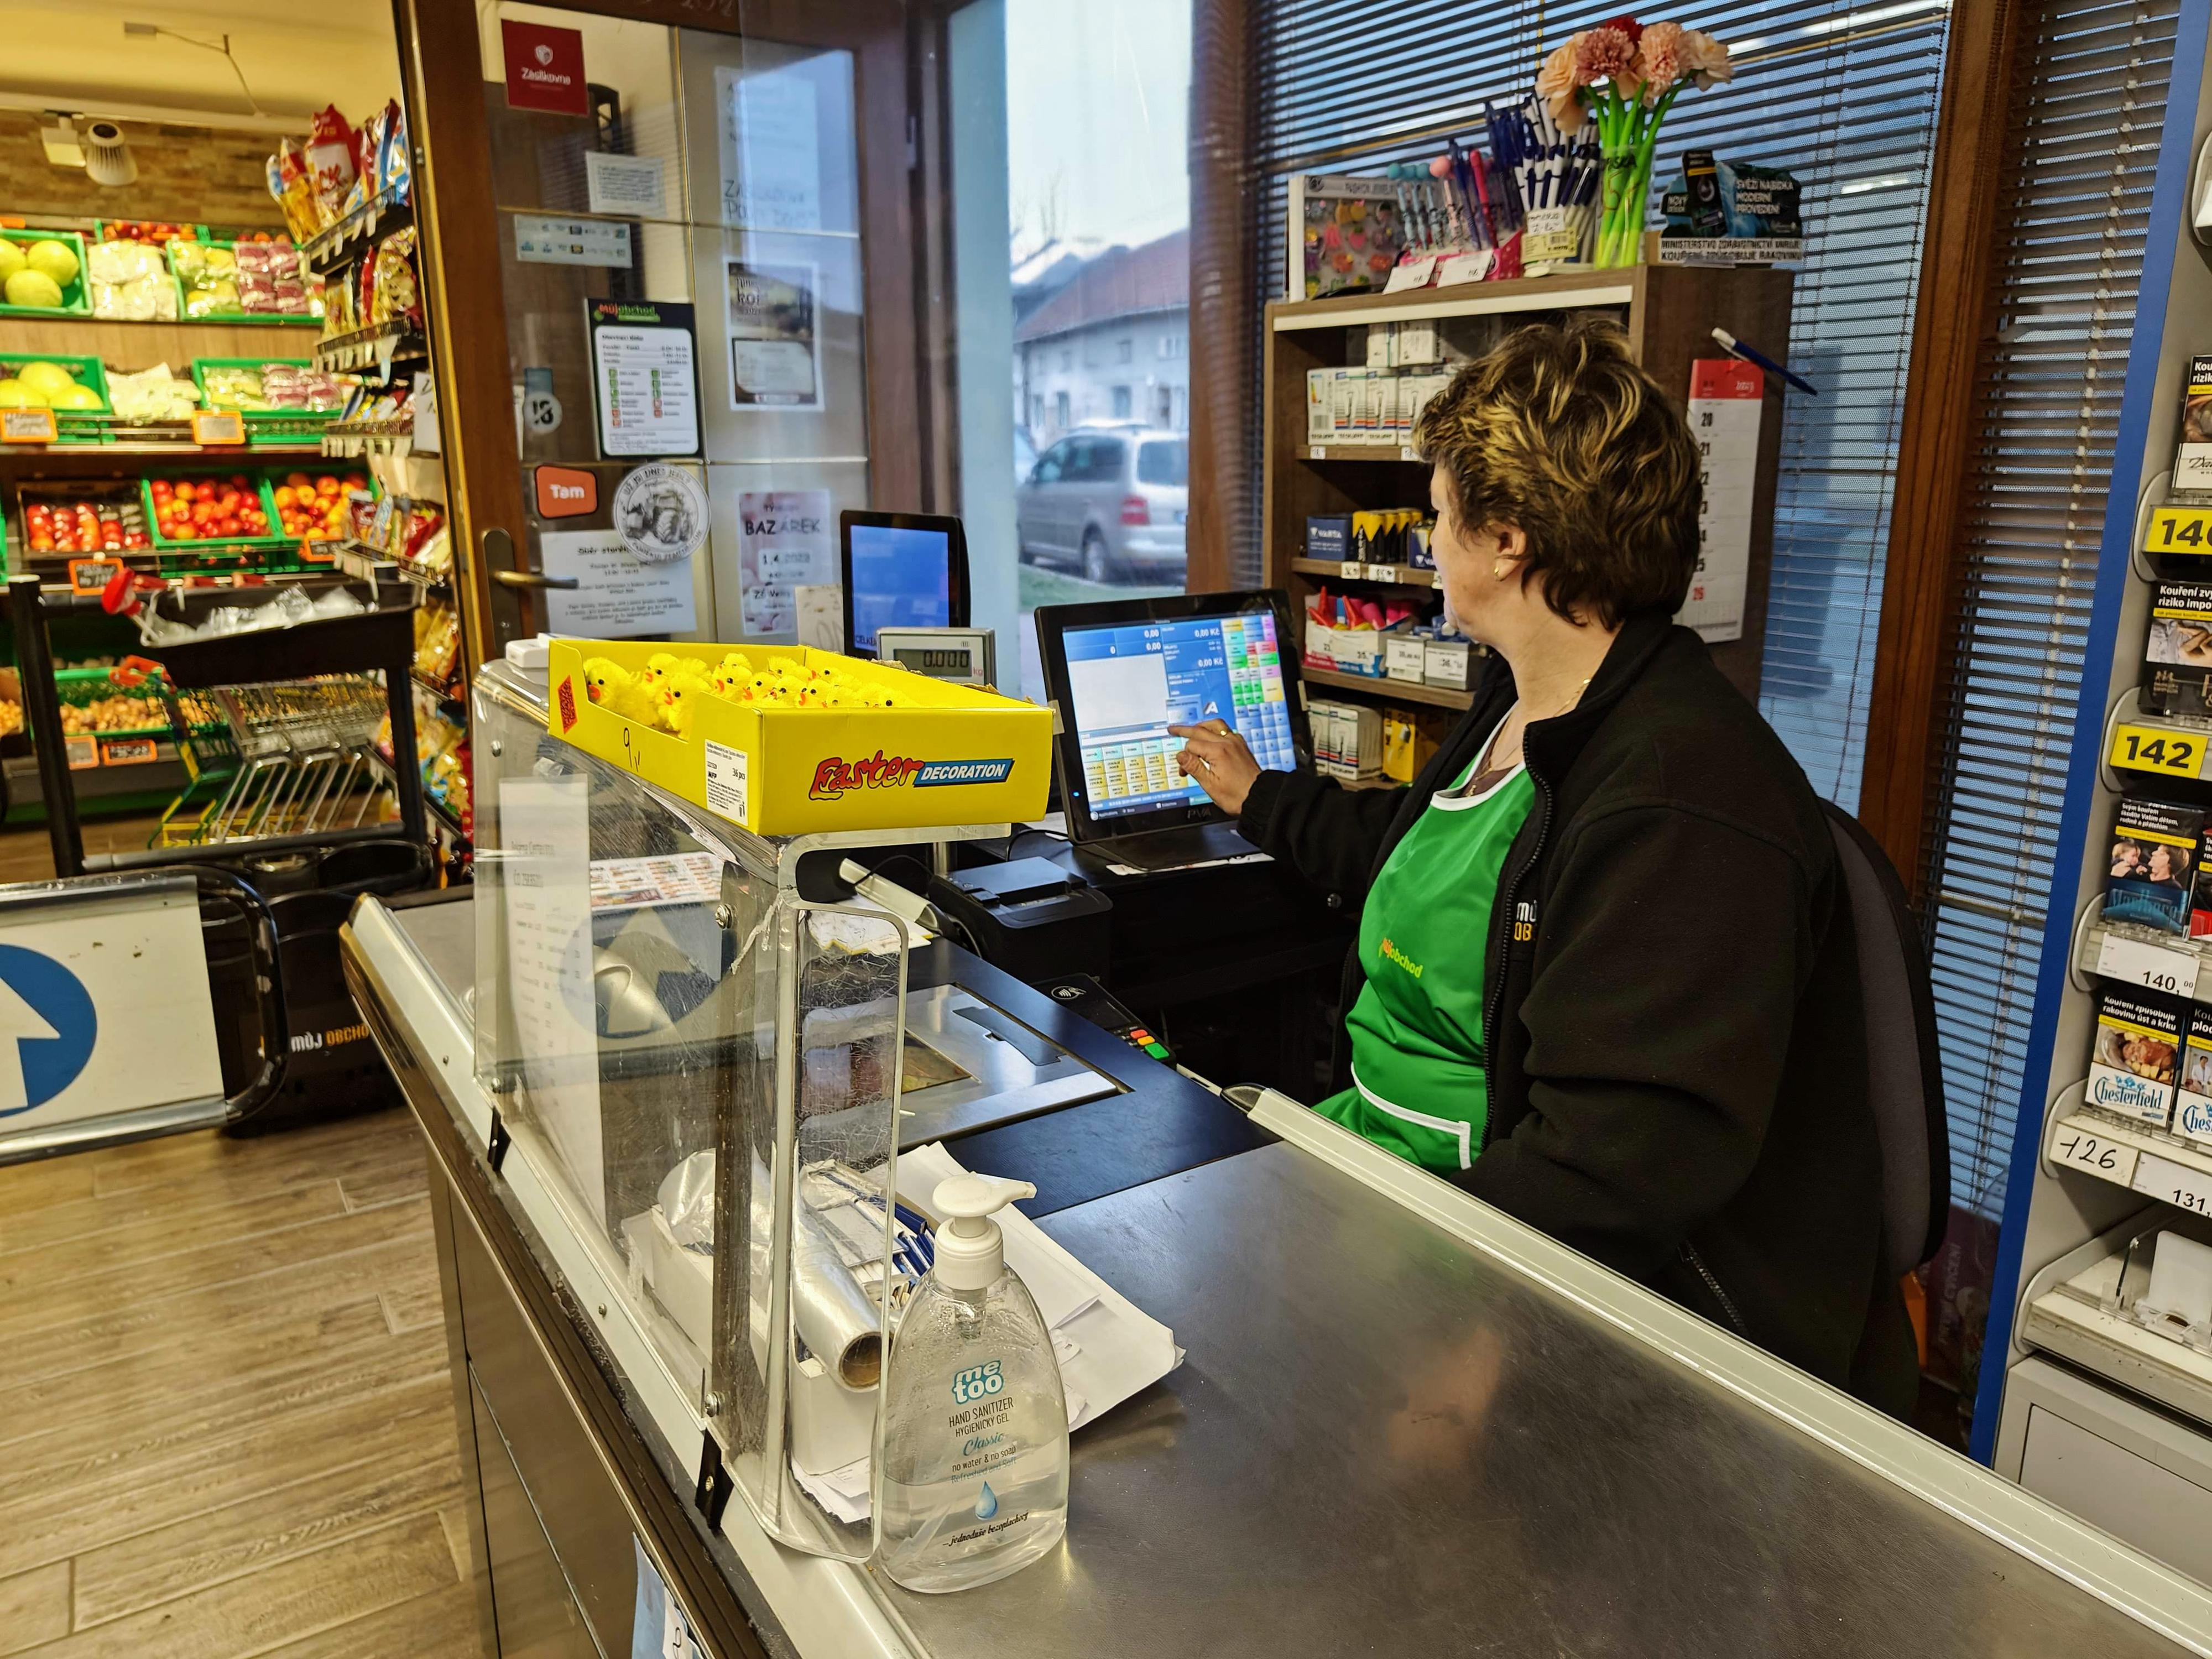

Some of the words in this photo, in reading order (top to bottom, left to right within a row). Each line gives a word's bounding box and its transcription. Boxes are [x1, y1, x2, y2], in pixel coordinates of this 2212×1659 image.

[1701, 413, 1713, 427] 20
[549, 484, 585, 499] Tam
[2158, 597, 2184, 608] riziko
[2160, 585, 2198, 597] Kouření
[2126, 735, 2193, 769] 142
[808, 749, 925, 801] Easter
[920, 764, 1005, 781] DECORATION
[2103, 1005, 2136, 1020] rakovinu
[2137, 1013, 2150, 1024] úst
[2157, 1019, 2177, 1031] krku
[2094, 1076, 2163, 1109] Chesterfield
[2060, 1135, 2117, 1168] 126
[955, 1360, 1001, 1382] me
[952, 1373, 1004, 1405] too
[949, 1411, 971, 1428] HAND
[972, 1397, 1014, 1420] SANITIZER
[997, 1412, 1010, 1425] GEL
[963, 1432, 1005, 1456] Classic
[952, 1463, 961, 1472] no
[963, 1457, 982, 1469] water
[984, 1453, 989, 1463] &
[991, 1452, 999, 1460] no
[1001, 1446, 1016, 1458] soap
